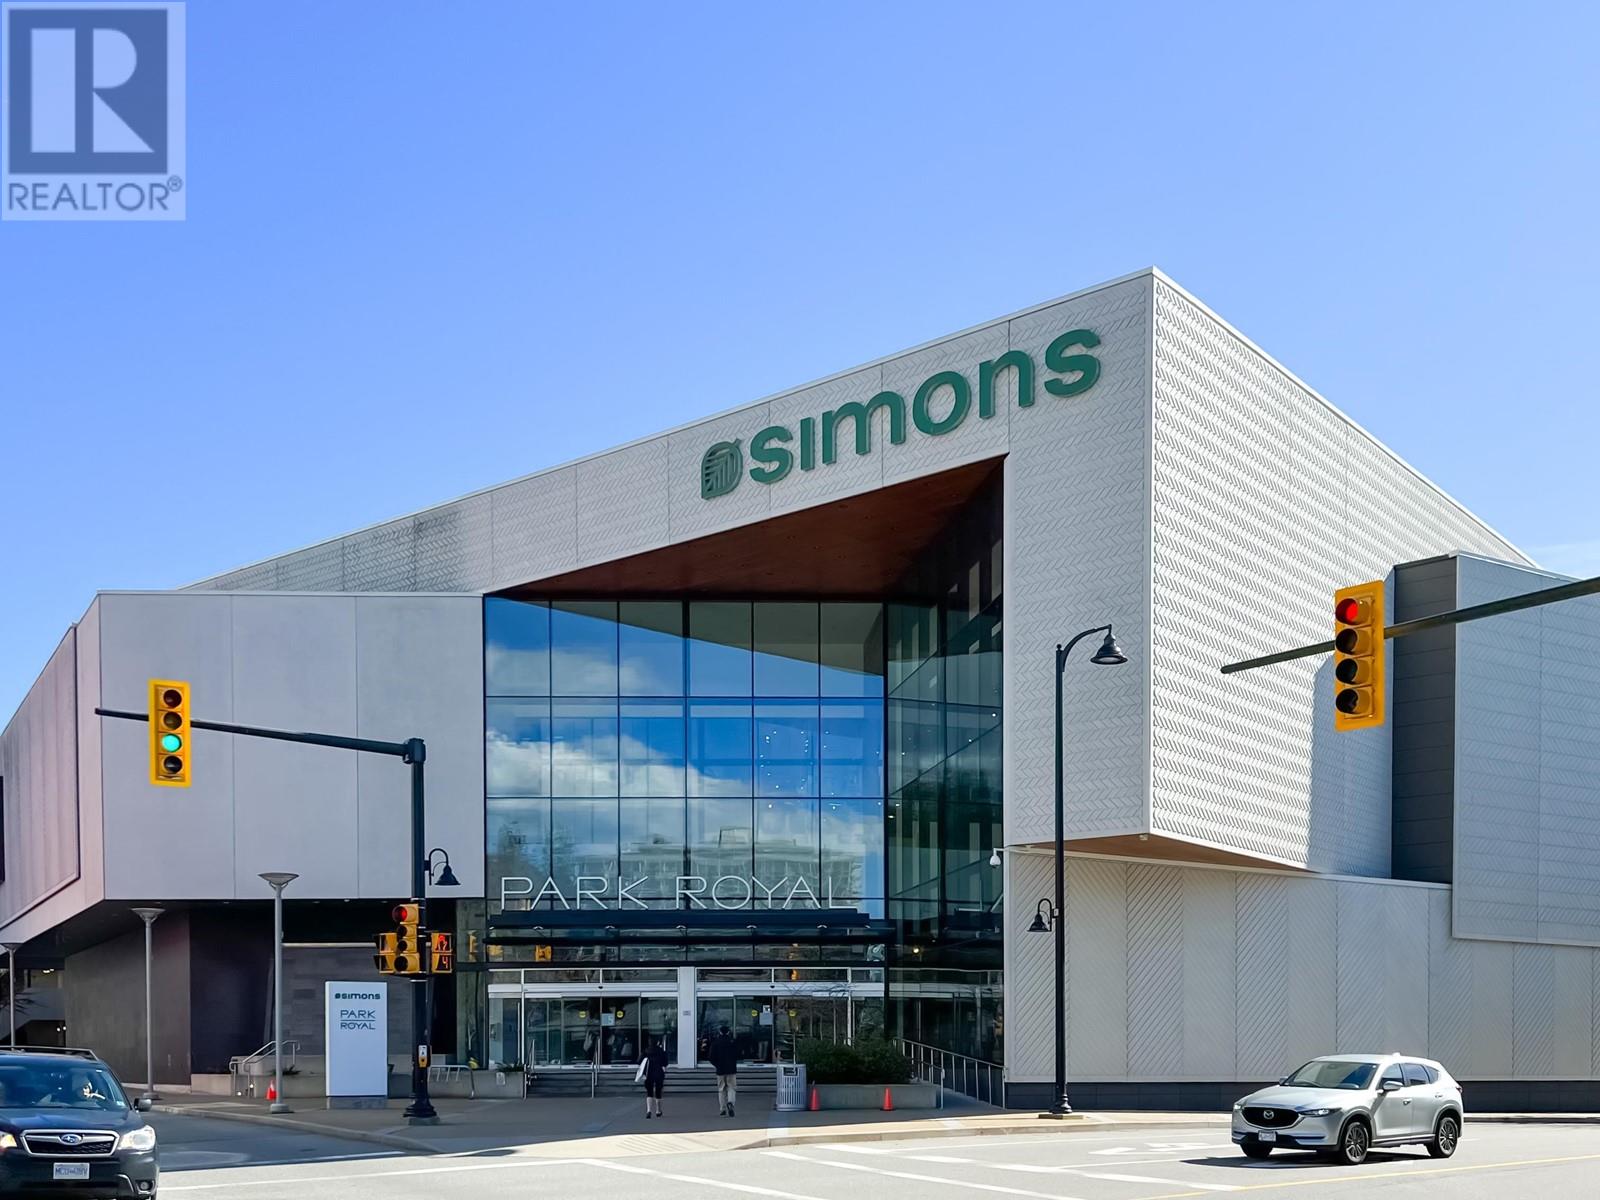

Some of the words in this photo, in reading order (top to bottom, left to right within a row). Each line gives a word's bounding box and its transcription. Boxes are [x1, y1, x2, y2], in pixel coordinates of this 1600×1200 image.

[749, 328, 1101, 485] simons
[501, 876, 648, 910] PARK
[676, 875, 857, 910] ROYAL
[340, 1009, 376, 1019] PARK
[340, 1022, 376, 1030] ROYAL
